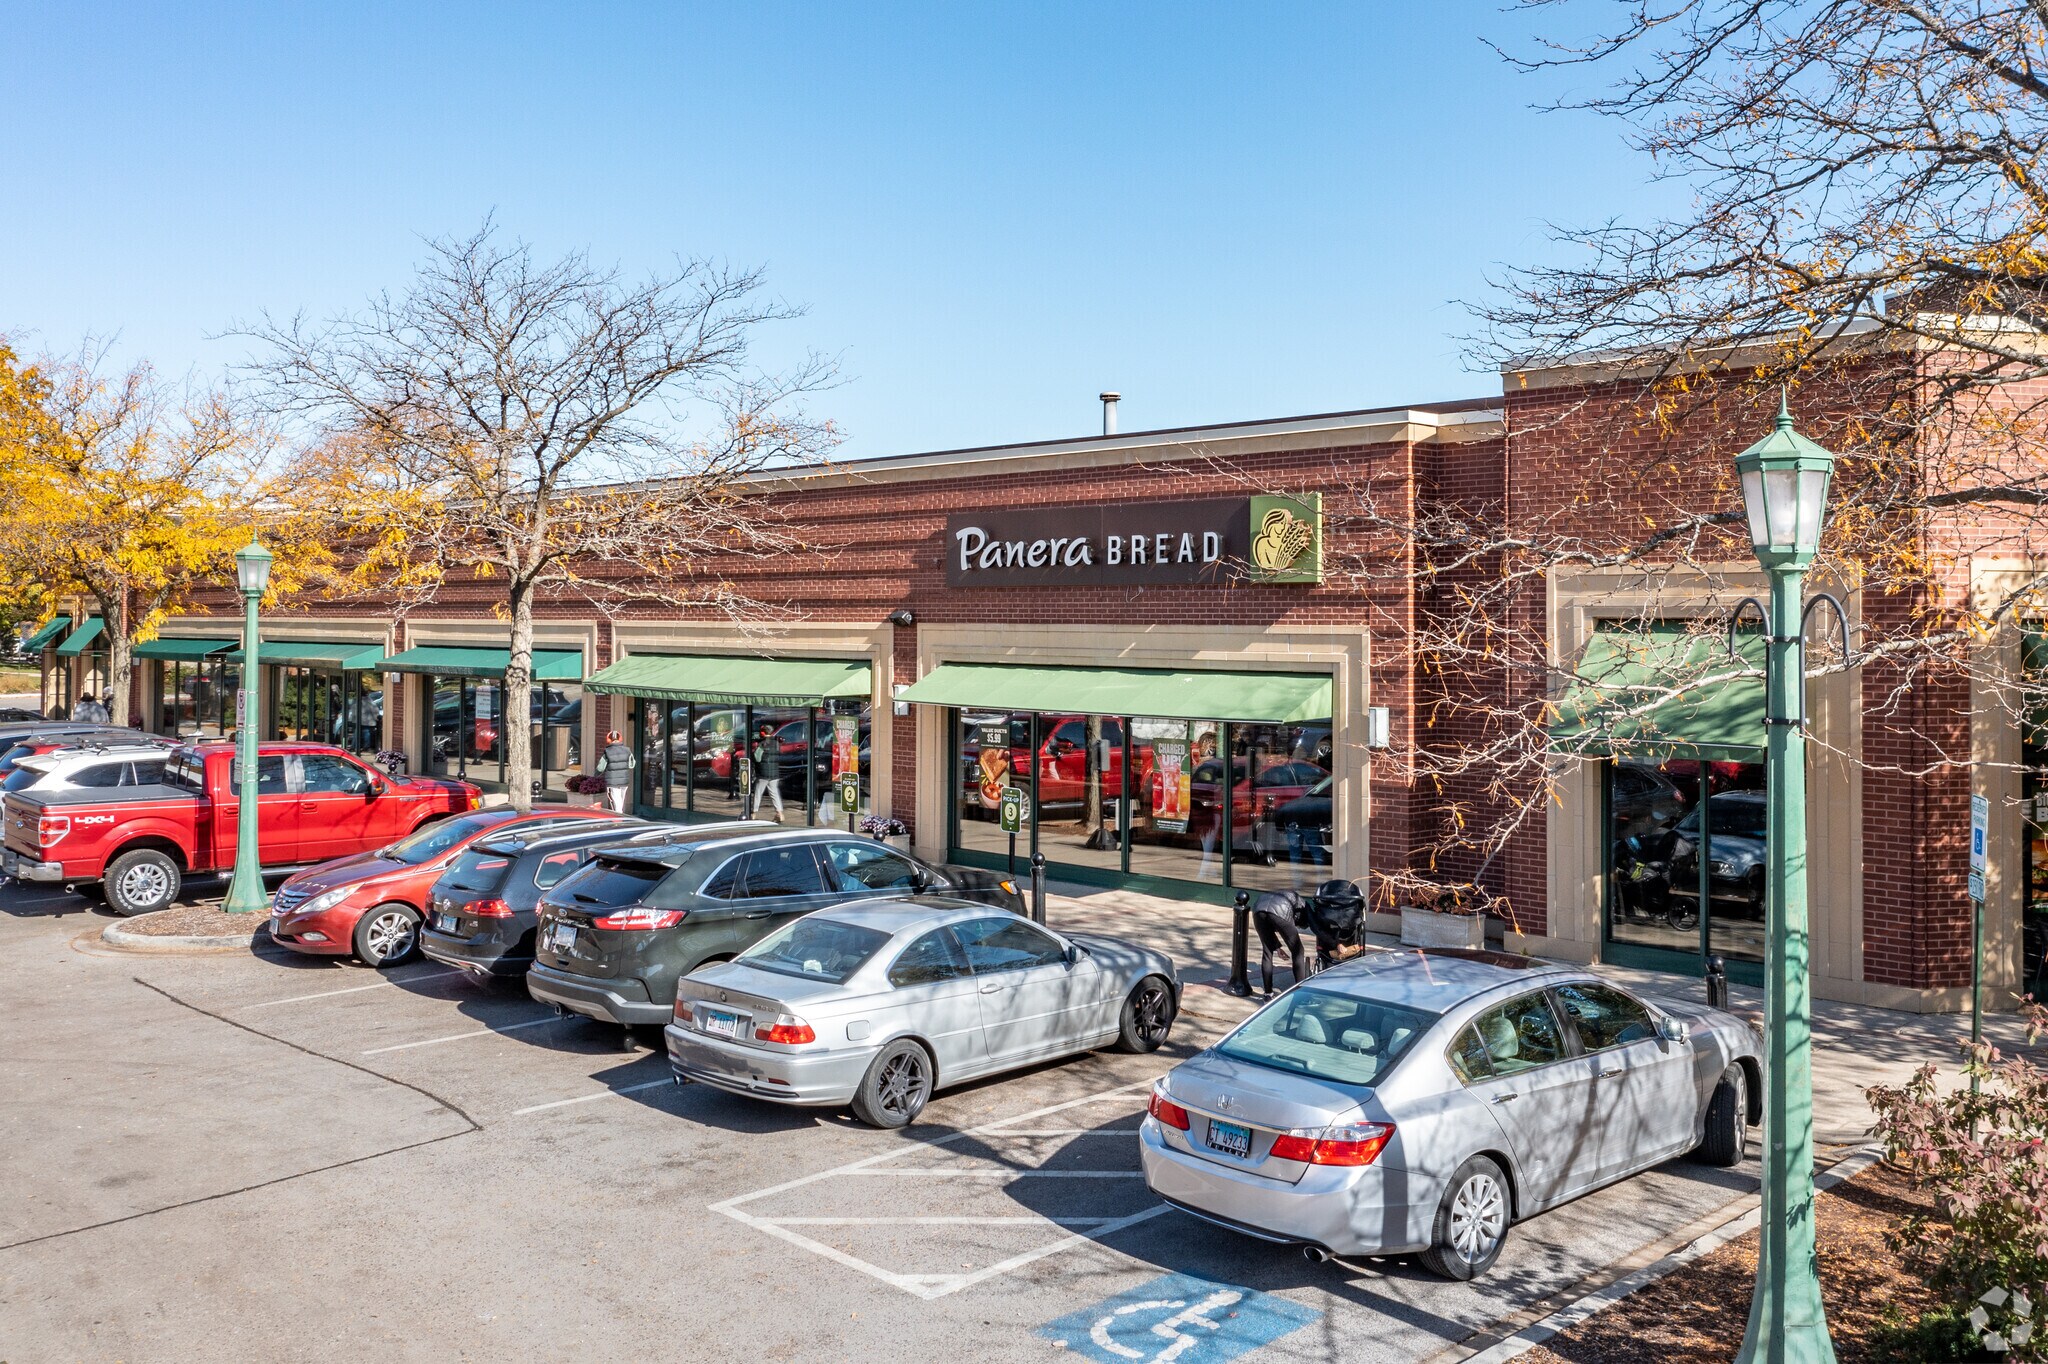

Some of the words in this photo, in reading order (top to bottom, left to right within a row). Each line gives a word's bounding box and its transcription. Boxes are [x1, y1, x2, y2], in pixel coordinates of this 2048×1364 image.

[955, 526, 1093, 571] Panera
[1107, 531, 1222, 565] BREAD
[987, 733, 1001, 744] $5.99
[1158, 743, 1186, 755] CHARGED
[1161, 754, 1181, 766] UP!
[847, 790, 852, 799] 2
[1008, 807, 1013, 817] 3
[1208, 1127, 1220, 1142] CT
[1222, 1130, 1248, 1151] 49233
